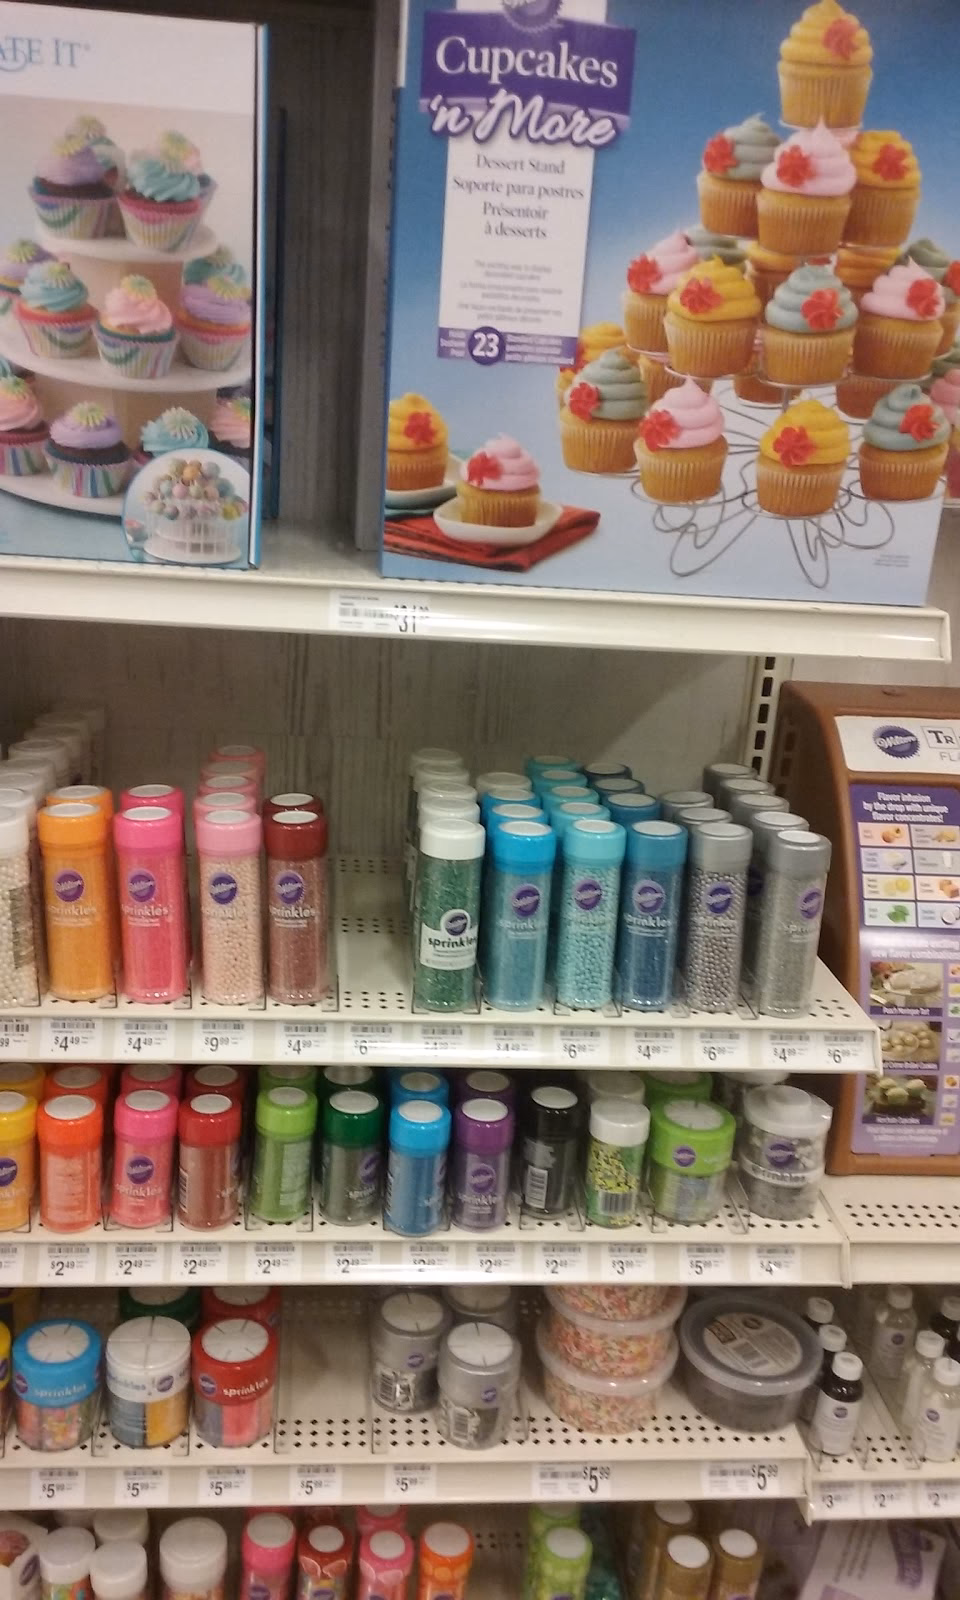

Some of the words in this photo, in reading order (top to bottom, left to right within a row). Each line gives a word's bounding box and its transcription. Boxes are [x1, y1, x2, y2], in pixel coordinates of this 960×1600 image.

[435, 36, 618, 88] Cupcakes
[476, 89, 616, 146] More
[476, 153, 524, 171] Dessert
[528, 160, 565, 174] Stand
[453, 176, 503, 194] Soporte
[506, 182, 535, 197] para
[537, 185, 584, 200] postres
[483, 201, 549, 219] Présentoir
[495, 221, 547, 238] desserts
[472, 331, 500, 358] 23
[927, 729, 960, 745] TR
